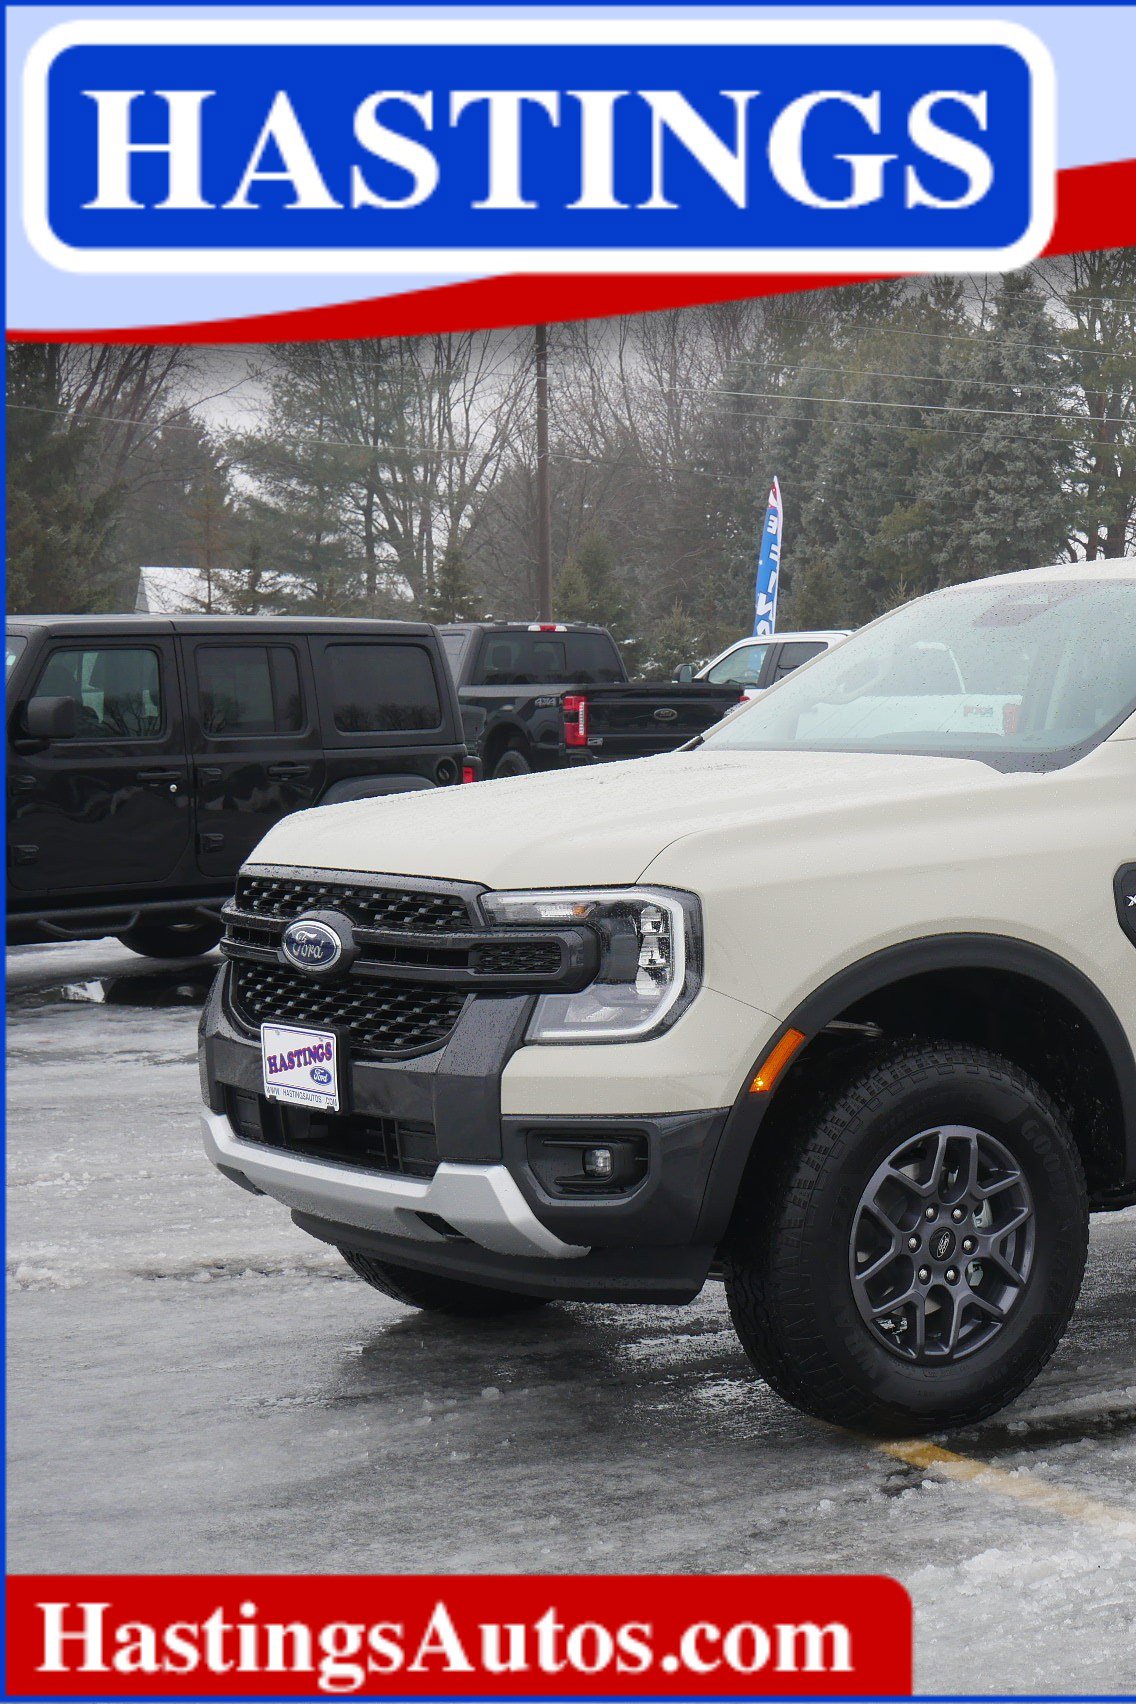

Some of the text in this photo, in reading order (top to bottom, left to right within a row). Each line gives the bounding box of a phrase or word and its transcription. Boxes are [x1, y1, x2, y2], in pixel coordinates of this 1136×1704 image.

[292, 930, 325, 959] Ford
[267, 1041, 332, 1075] HASTINGS
[313, 1068, 329, 1083] Ford
